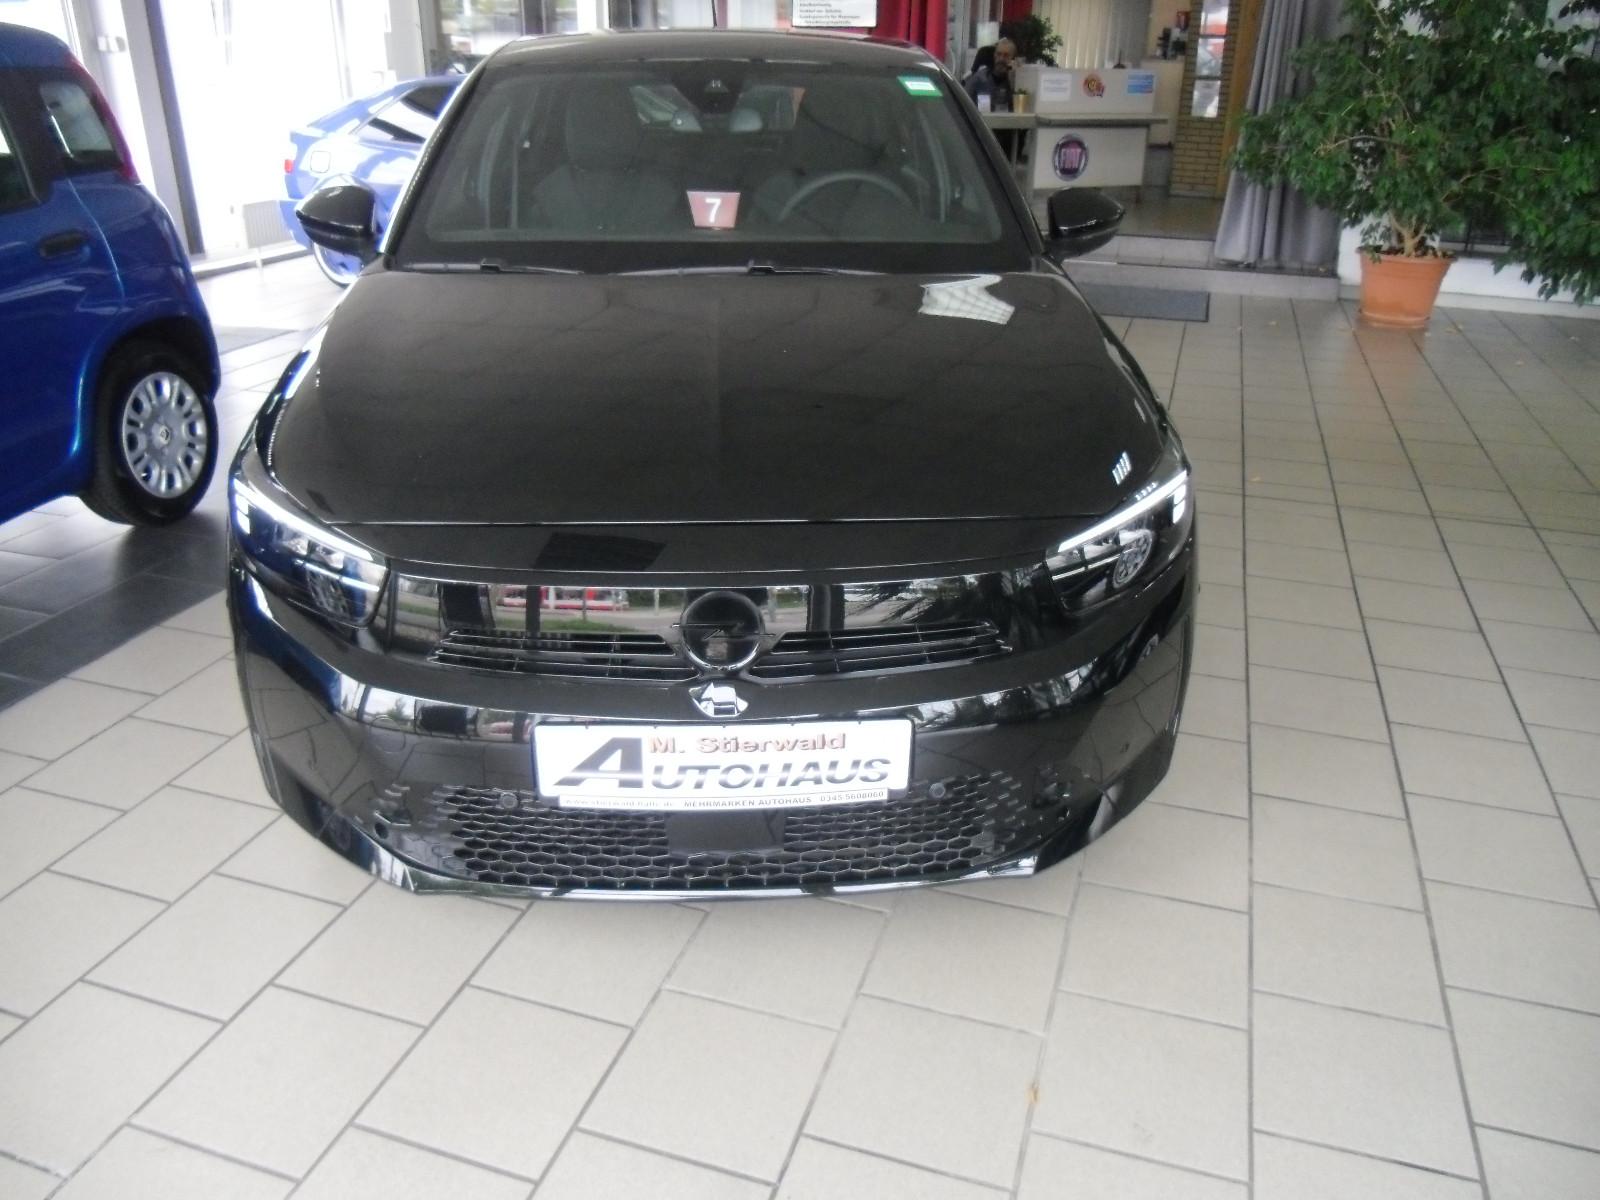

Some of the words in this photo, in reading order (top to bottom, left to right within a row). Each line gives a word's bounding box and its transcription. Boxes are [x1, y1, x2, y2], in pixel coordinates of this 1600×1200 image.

[705, 198, 722, 223] 7
[650, 736, 686, 754] M.
[697, 733, 847, 754] Stierwald
[553, 737, 891, 790] AUTOHAUS
[684, 799, 755, 808] MEHRMARKEN
[758, 796, 812, 806] AUTOHAUS
